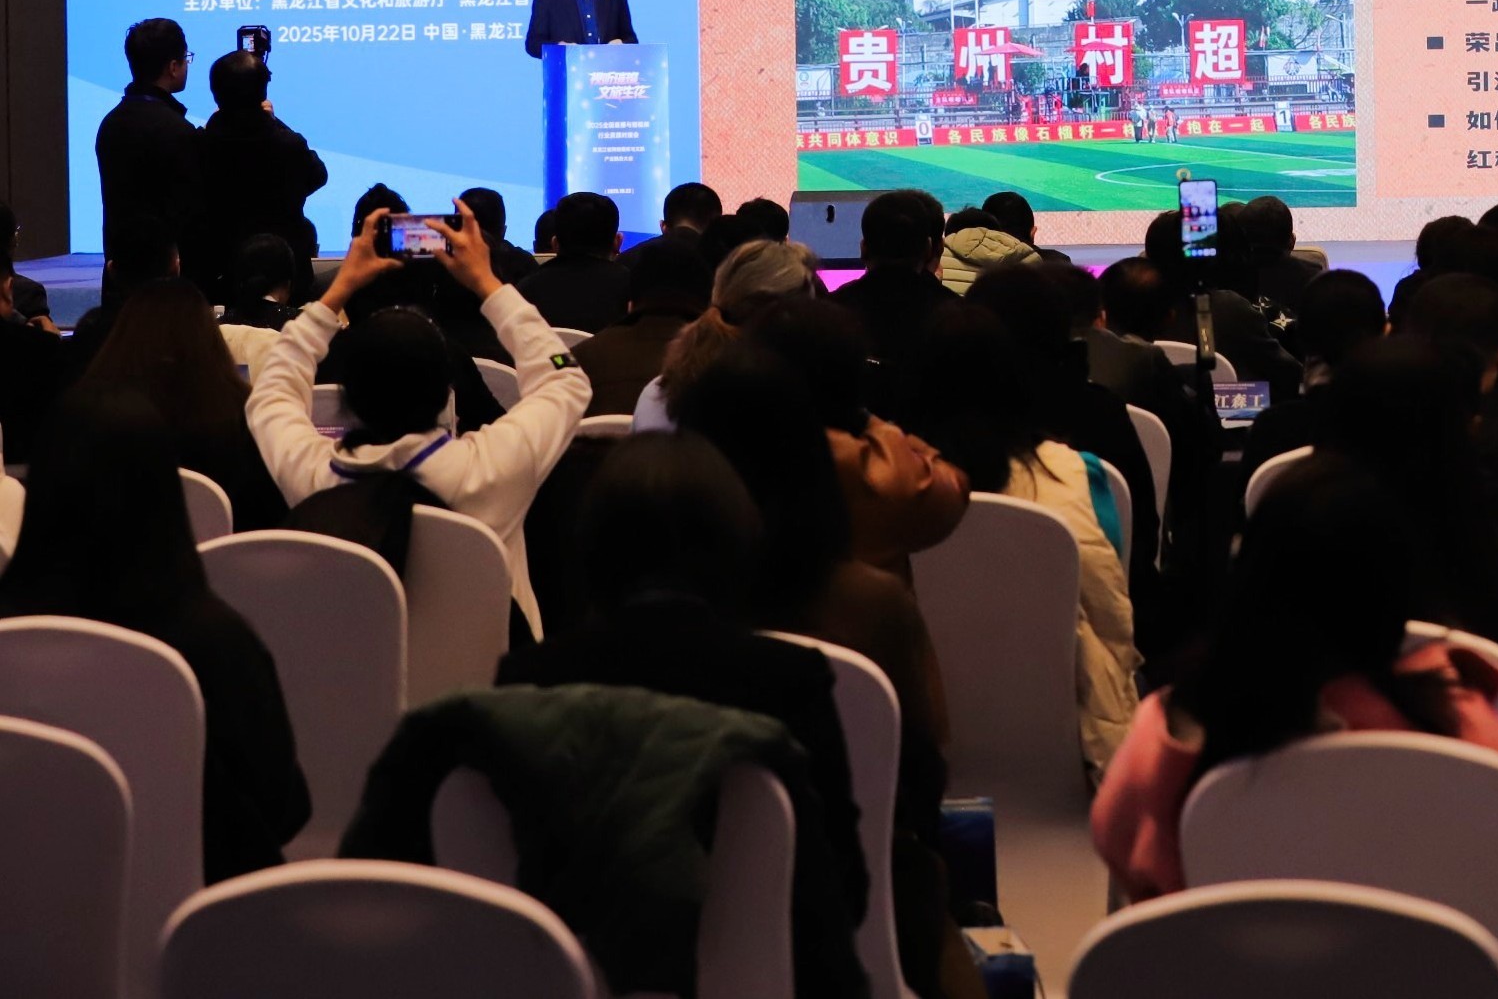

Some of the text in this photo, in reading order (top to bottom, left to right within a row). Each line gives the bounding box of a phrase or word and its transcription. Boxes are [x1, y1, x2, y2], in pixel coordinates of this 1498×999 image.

[277, 22, 523, 43] 2025年10月22日 中国·黑龙江
